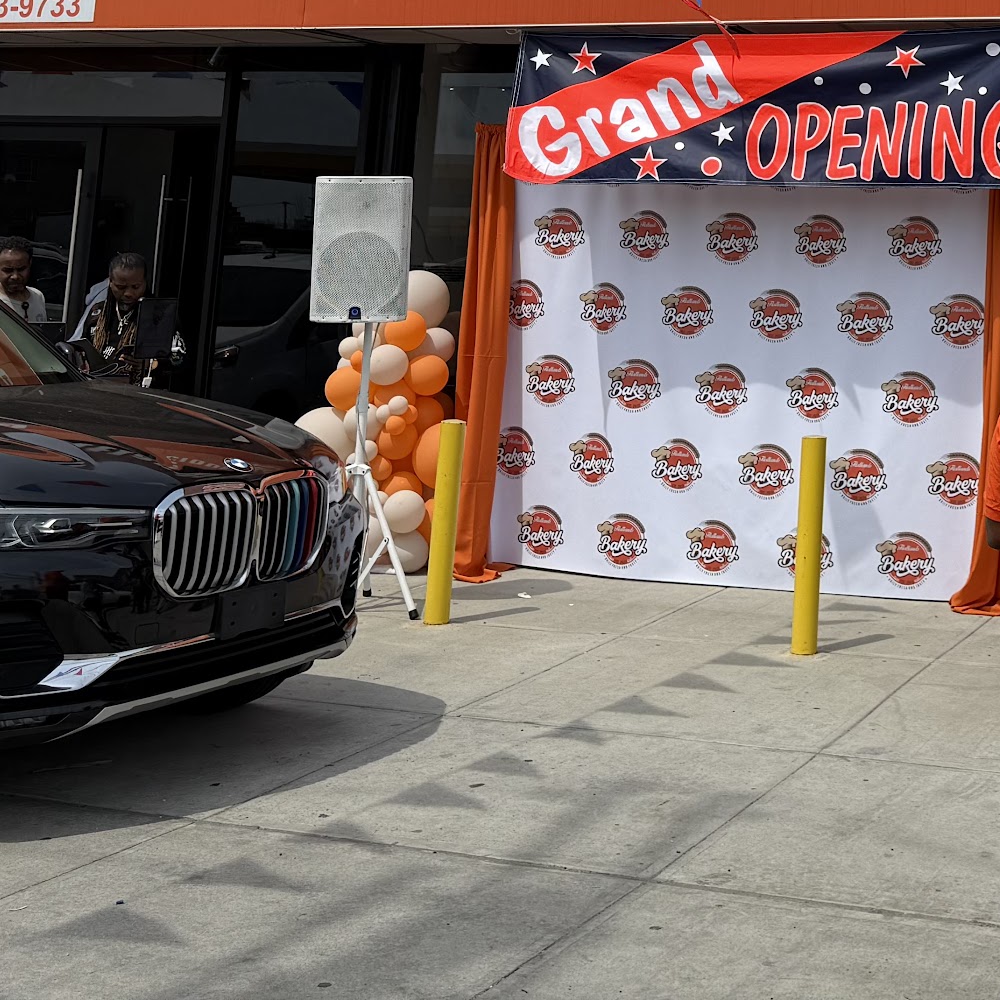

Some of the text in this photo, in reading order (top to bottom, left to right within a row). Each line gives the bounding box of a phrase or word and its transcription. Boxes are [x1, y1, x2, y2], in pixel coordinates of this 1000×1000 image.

[518, 40, 745, 179] Grand
[536, 228, 585, 248] Bakery
[620, 228, 669, 250] Bakery
[706, 230, 758, 252] Bakery
[795, 235, 847, 256] Bakery
[889, 236, 942, 258] Bakery
[580, 300, 626, 322] Bakery
[662, 305, 714, 327] Bakery
[750, 309, 803, 331] Bakery
[837, 312, 894, 335] Bakery
[526, 374, 575, 396] Bakery
[608, 379, 661, 401] Bakery
[695, 384, 748, 406] Bakery
[787, 389, 840, 411] Bakery
[882, 393, 939, 416] Bakery
[570, 453, 614, 475] Bakery
[651, 459, 702, 482] Bakery
[739, 466, 795, 488] Bakery
[831, 470, 887, 493] Bakery
[517, 525, 564, 547] Bakery
[597, 534, 648, 557] Bakery
[686, 541, 740, 564] Bakery
[878, 555, 936, 578] Bakery
